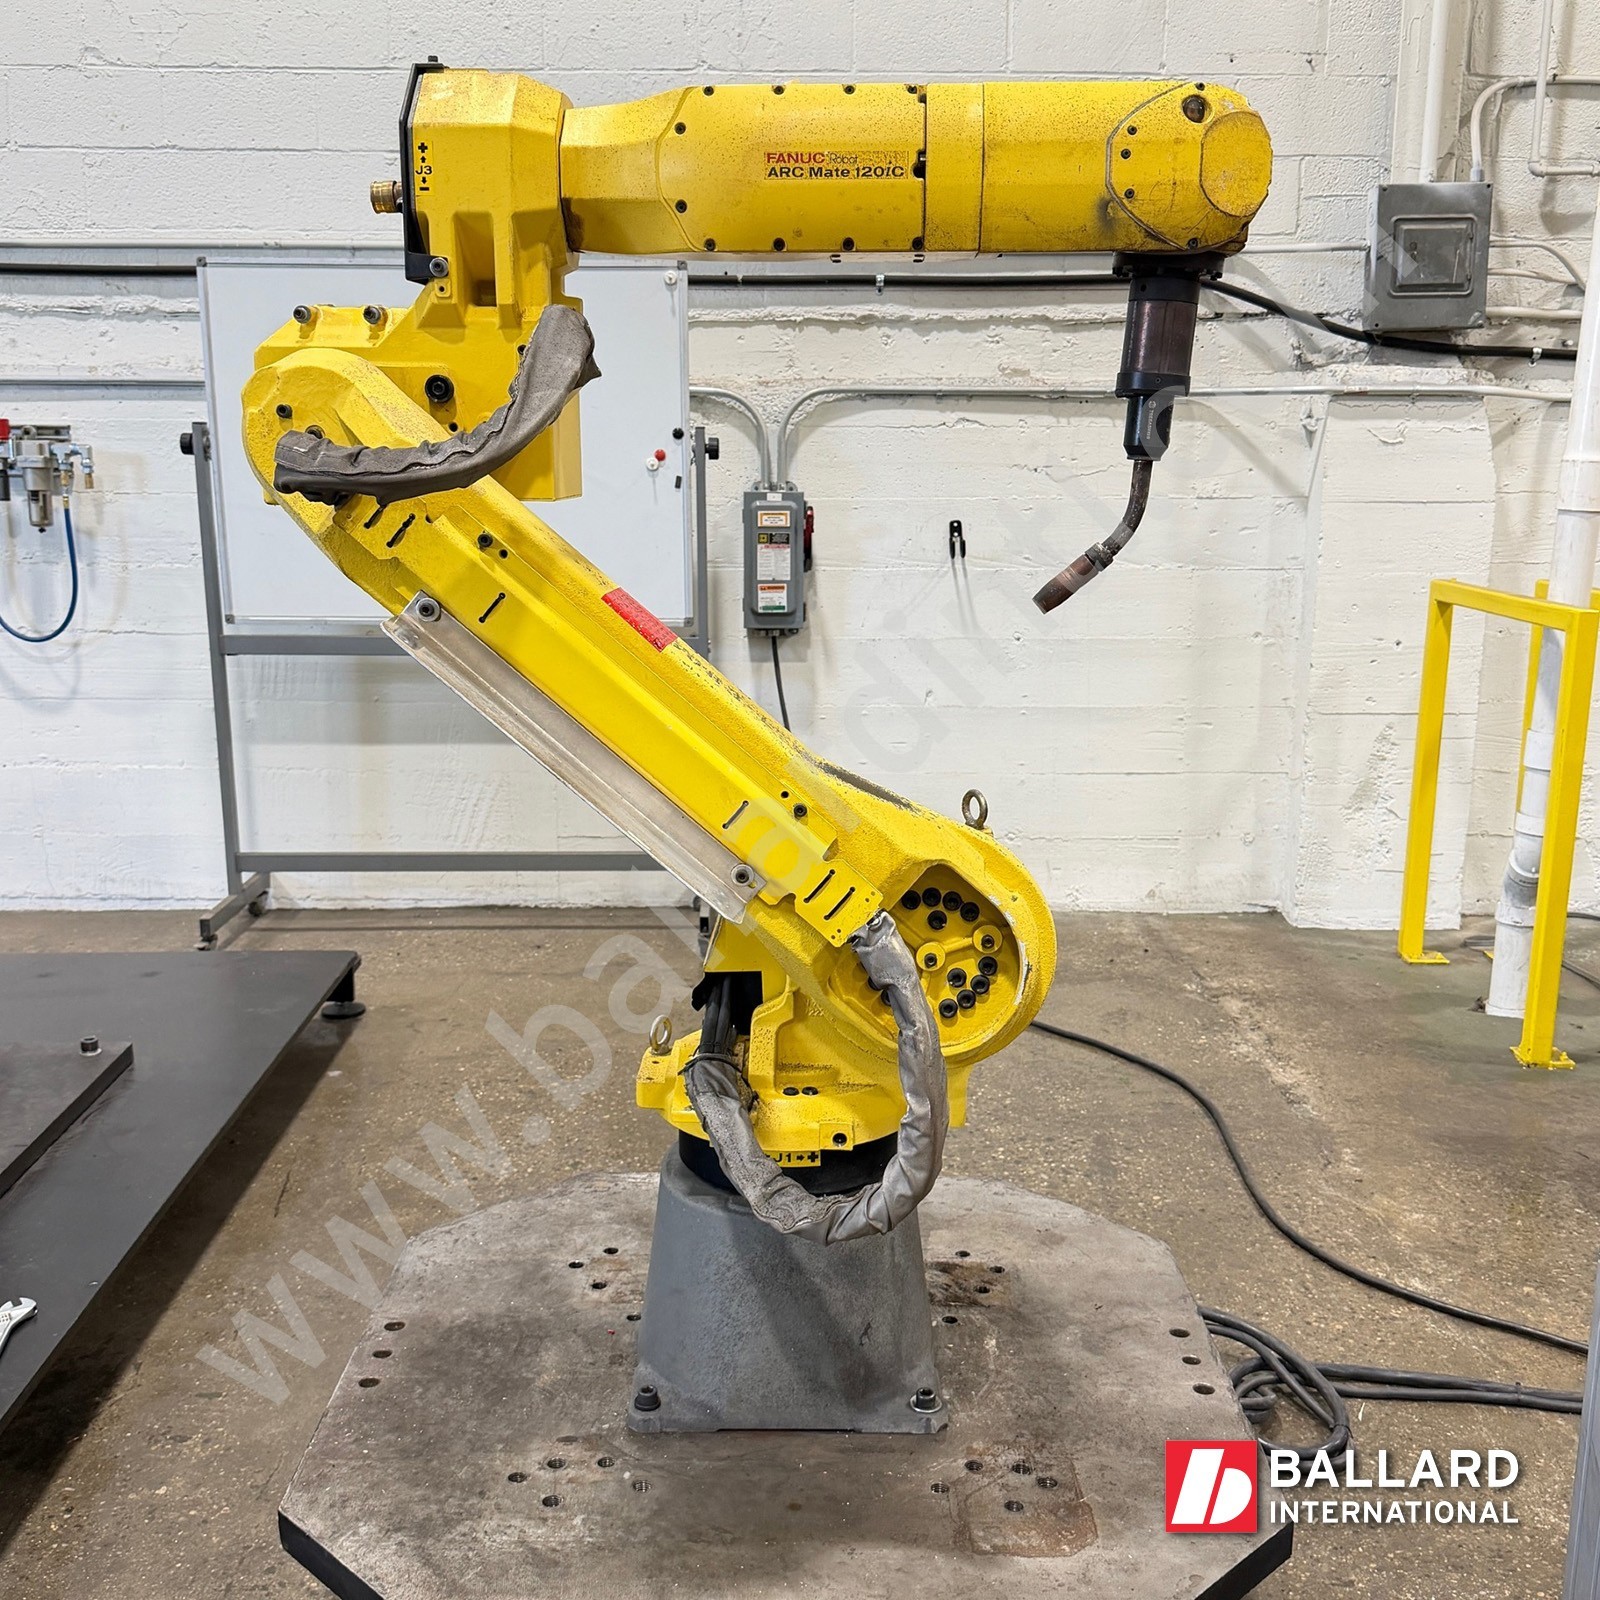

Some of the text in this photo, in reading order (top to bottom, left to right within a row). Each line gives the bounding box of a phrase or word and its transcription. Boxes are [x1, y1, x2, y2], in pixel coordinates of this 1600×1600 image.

[766, 152, 859, 164] FANUC Robot
[415, 165, 433, 175] J3
[767, 166, 804, 178] ARC
[808, 166, 851, 178] Mate
[773, 1152, 792, 1163] J1
